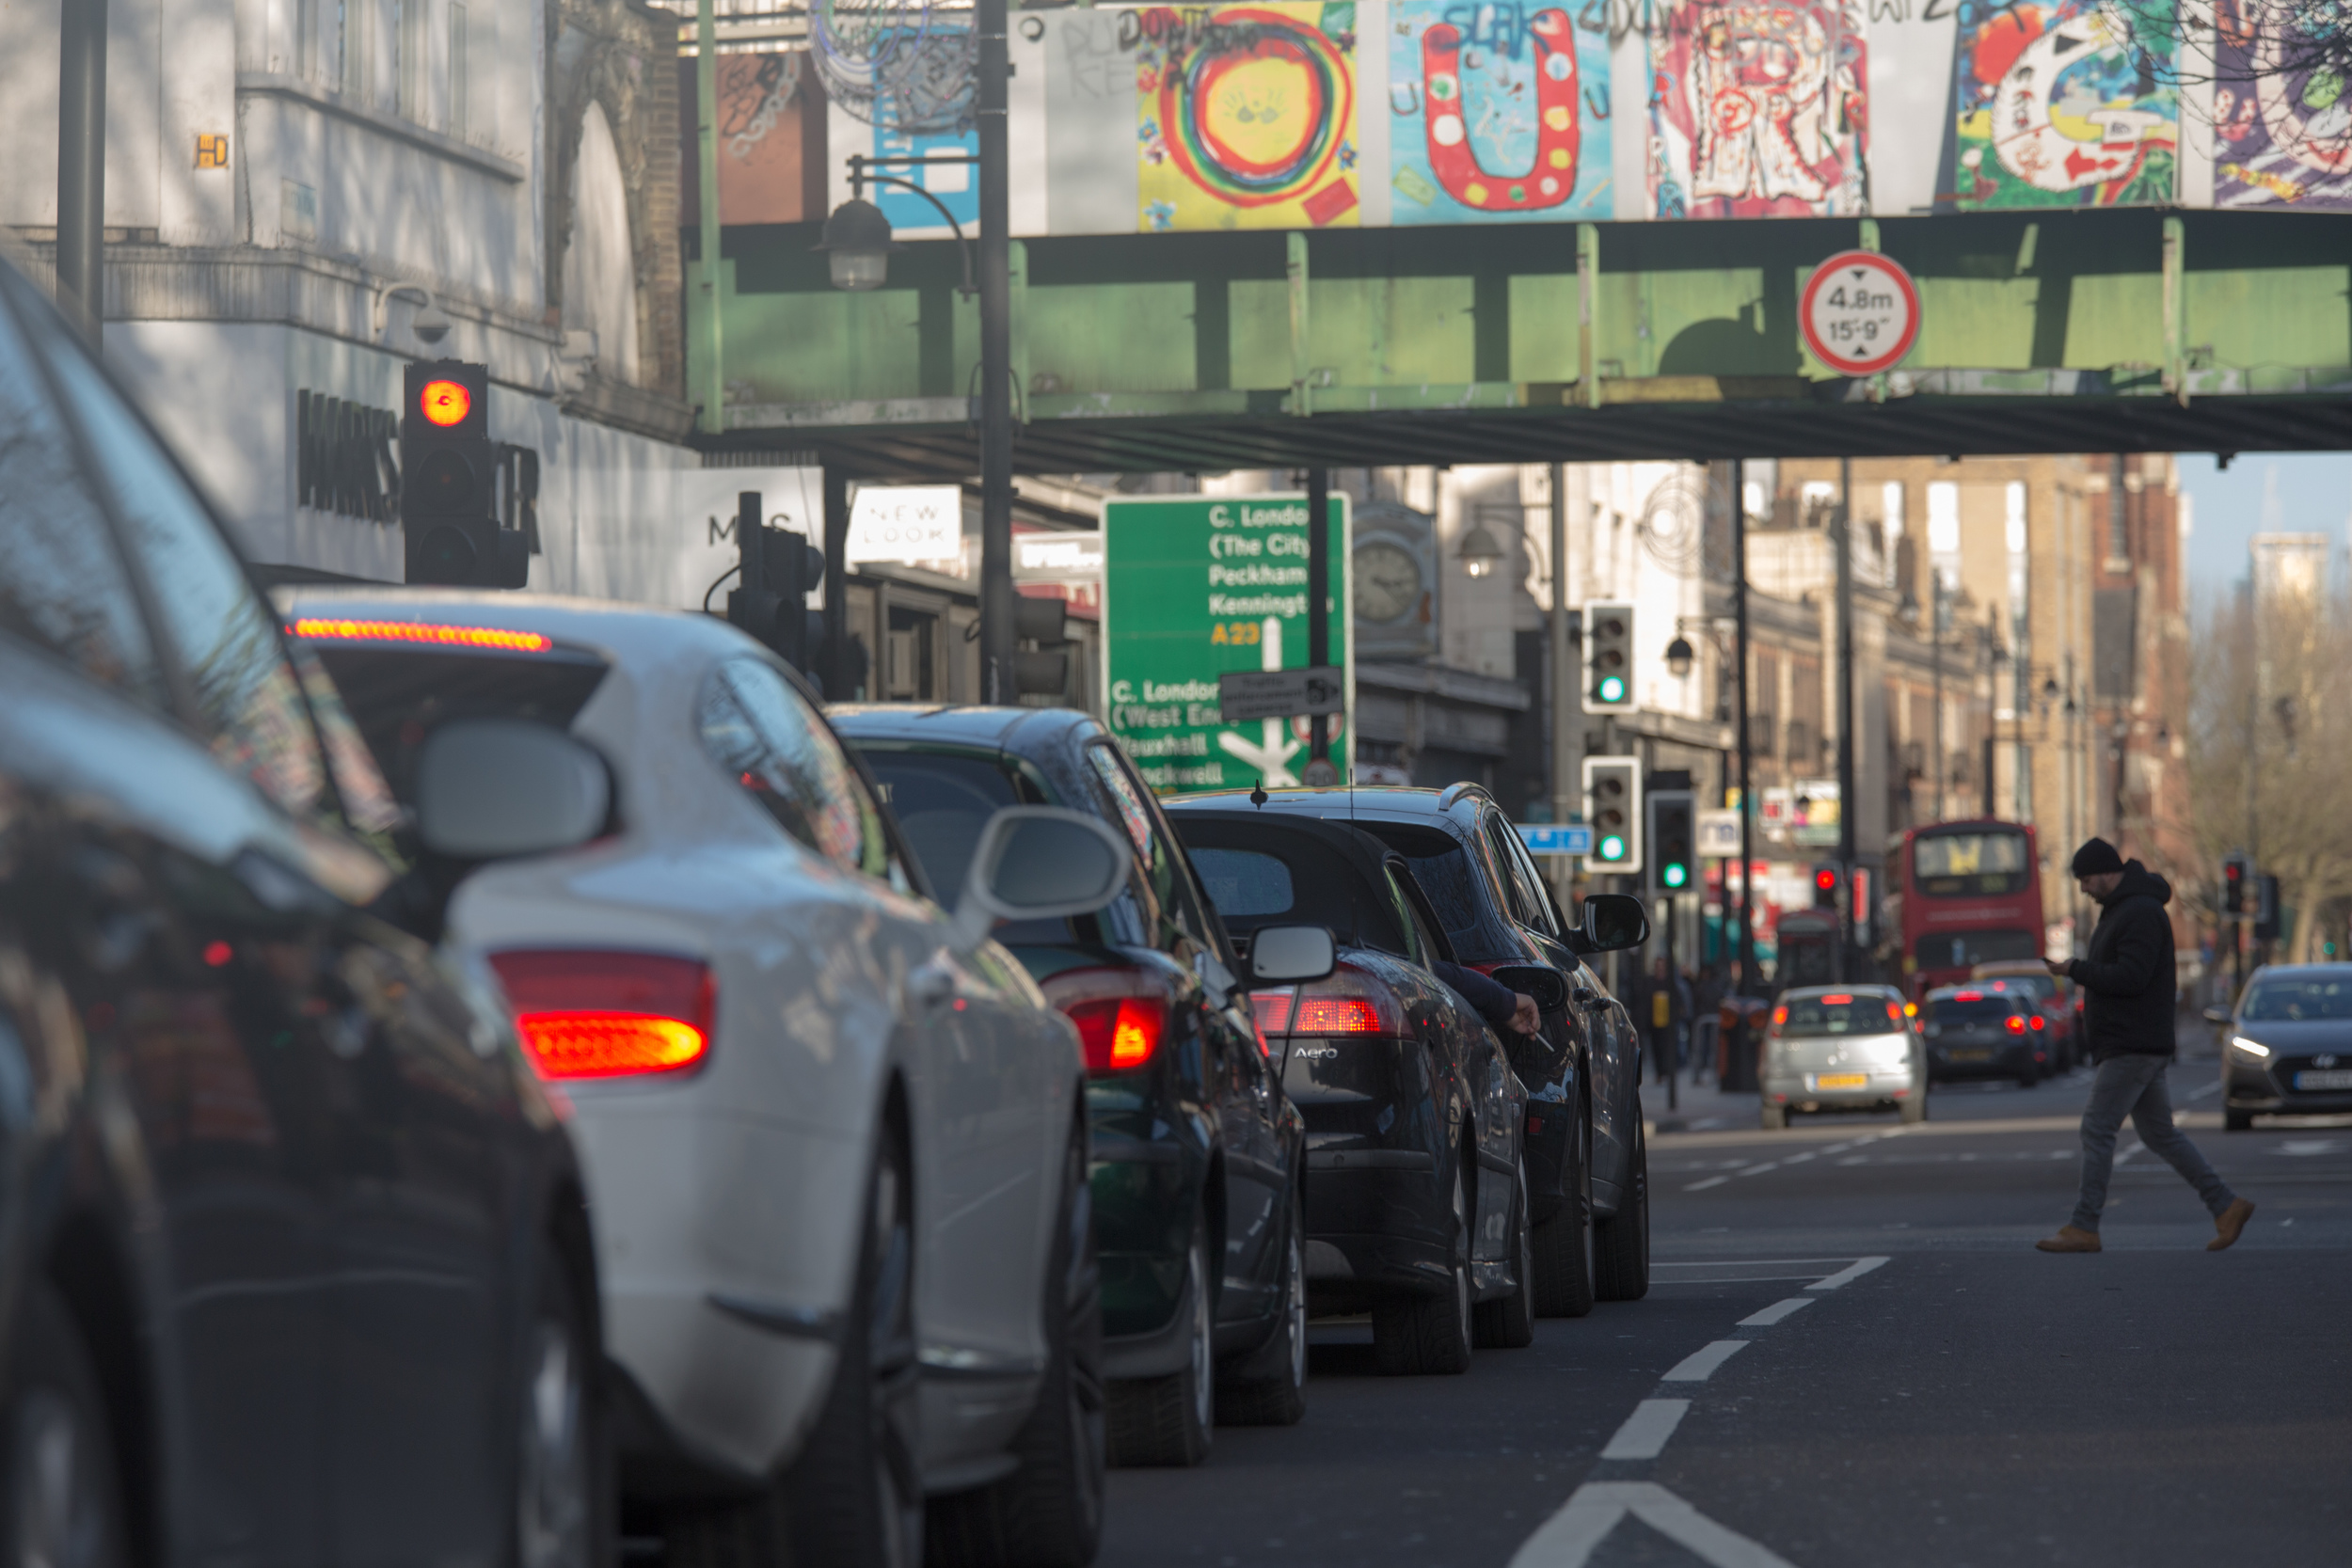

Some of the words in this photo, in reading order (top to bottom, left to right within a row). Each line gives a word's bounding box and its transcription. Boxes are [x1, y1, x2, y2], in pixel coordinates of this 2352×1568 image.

[1828, 286, 1893, 309] 4.8m
[869, 503, 940, 523] NEW
[1209, 504, 1235, 528] C.
[1241, 503, 1310, 528] Londo
[863, 526, 946, 545] LOOK
[1209, 532, 1263, 560] (The
[1266, 531, 1311, 559] City
[1209, 562, 1308, 587] Peckham
[1209, 592, 1334, 618] Kenningt
[1211, 622, 1261, 646] A23
[1112, 679, 1138, 703] C.
[1112, 704, 1182, 731] (West
[1139, 761, 1223, 785] ockwell
[1295, 1047, 1339, 1059] Aero
